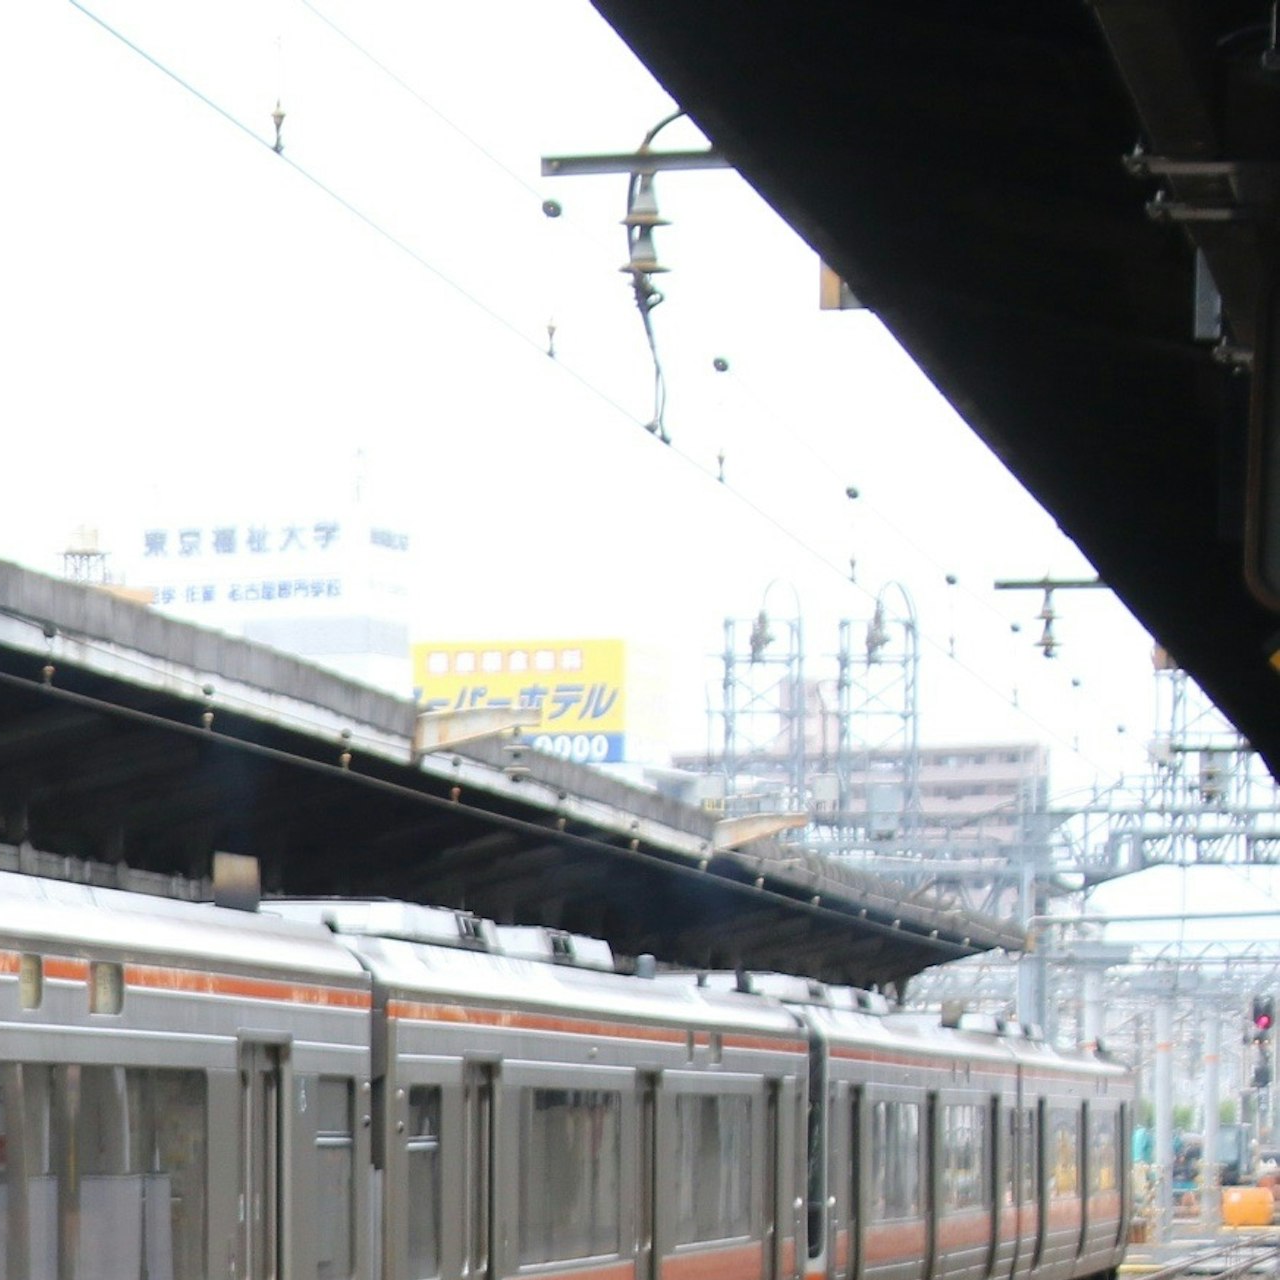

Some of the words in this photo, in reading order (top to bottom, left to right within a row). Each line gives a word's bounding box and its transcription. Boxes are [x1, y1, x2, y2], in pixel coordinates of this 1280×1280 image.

[144, 521, 340, 557] 東京福祉大学
